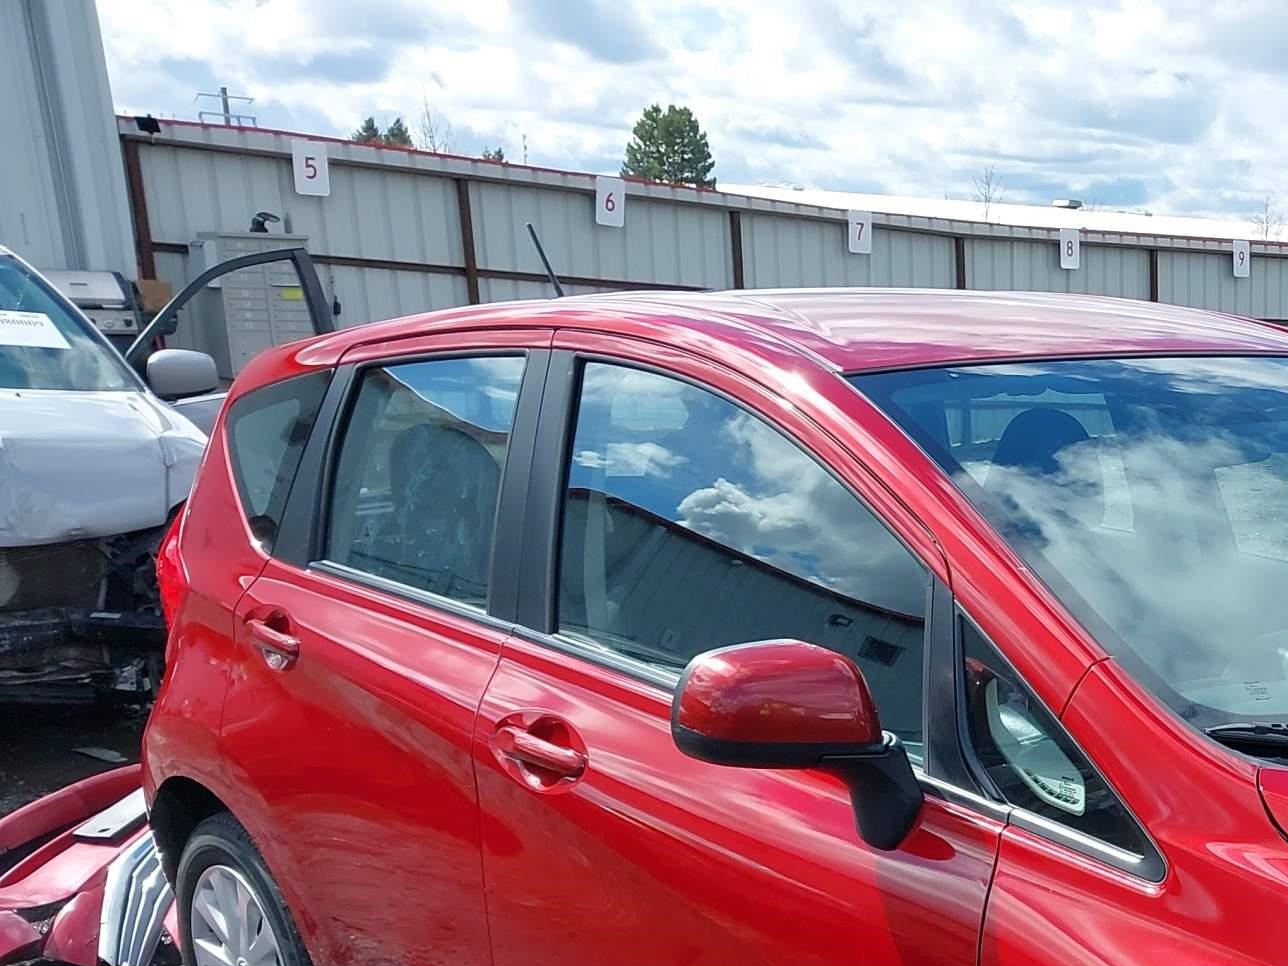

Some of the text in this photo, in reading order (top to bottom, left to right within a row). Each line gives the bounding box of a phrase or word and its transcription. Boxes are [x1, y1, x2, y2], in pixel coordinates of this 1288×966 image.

[304, 156, 317, 180] 5
[605, 191, 616, 212] 6
[855, 221, 865, 241] 7
[1066, 240, 1074, 257] 8
[1238, 250, 1245, 266] 9
